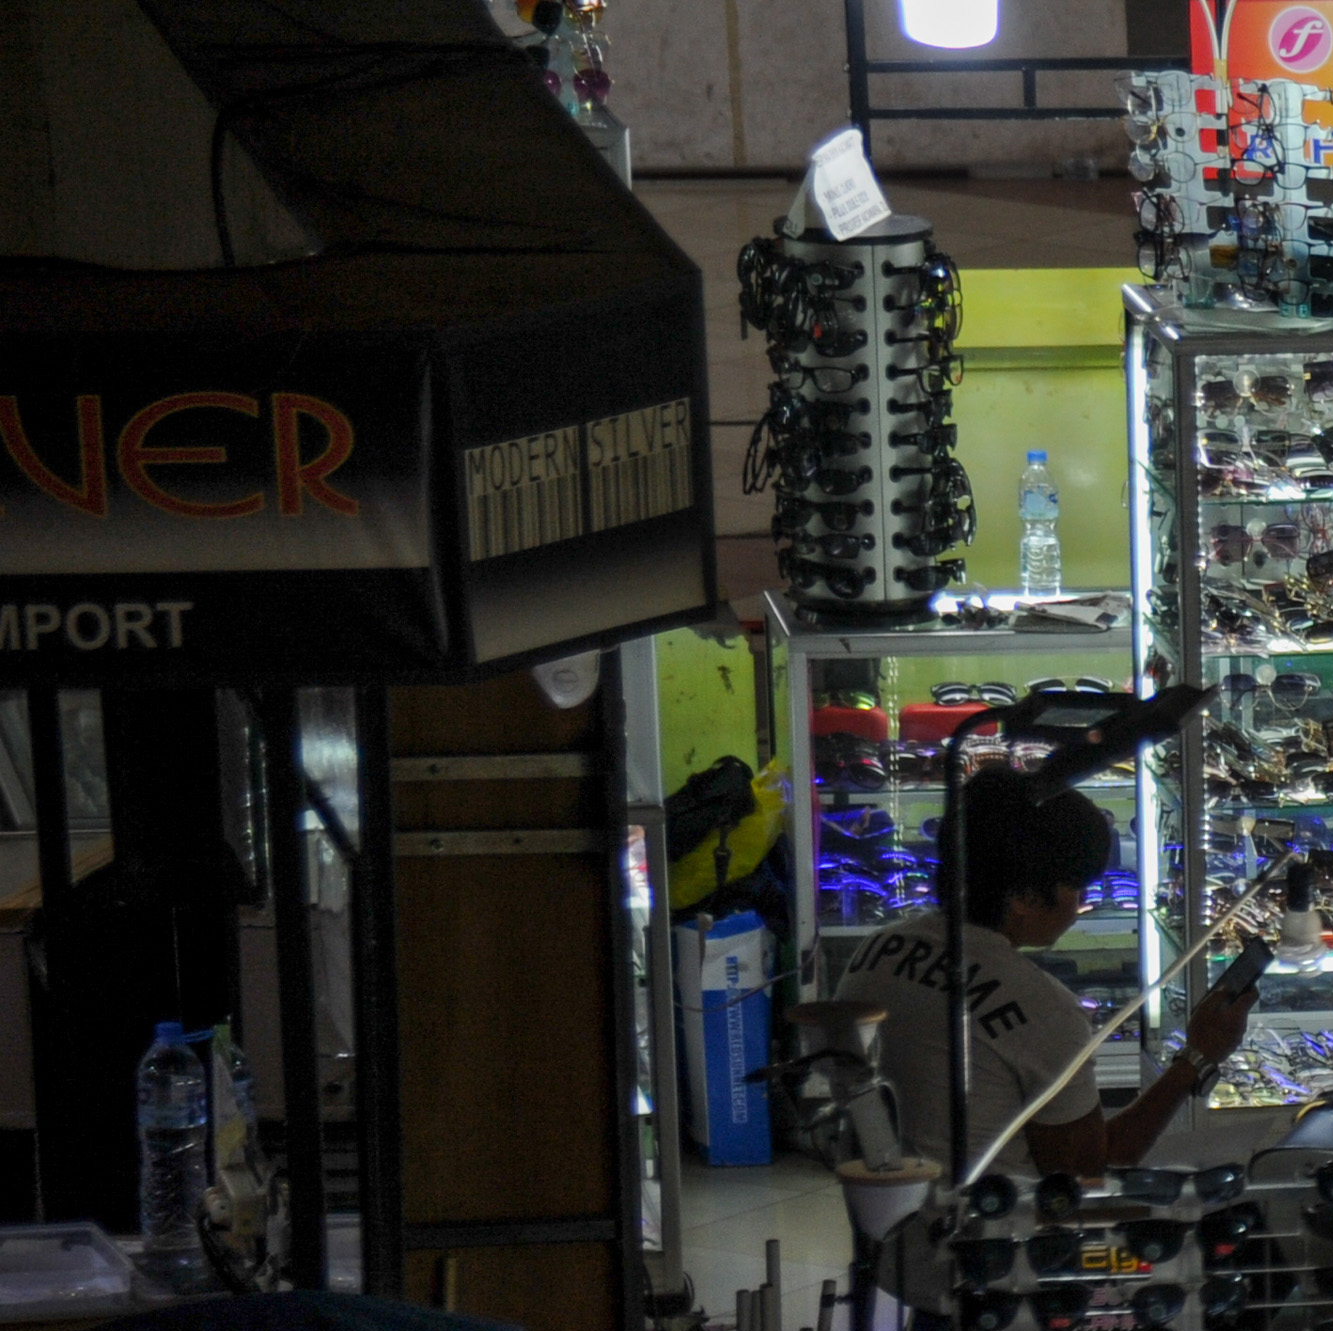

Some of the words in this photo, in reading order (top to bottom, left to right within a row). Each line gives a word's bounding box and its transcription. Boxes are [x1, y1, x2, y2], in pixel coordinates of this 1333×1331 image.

[0, 391, 360, 518] VER
[468, 429, 579, 495] MODERN
[591, 401, 690, 467] SILVER
